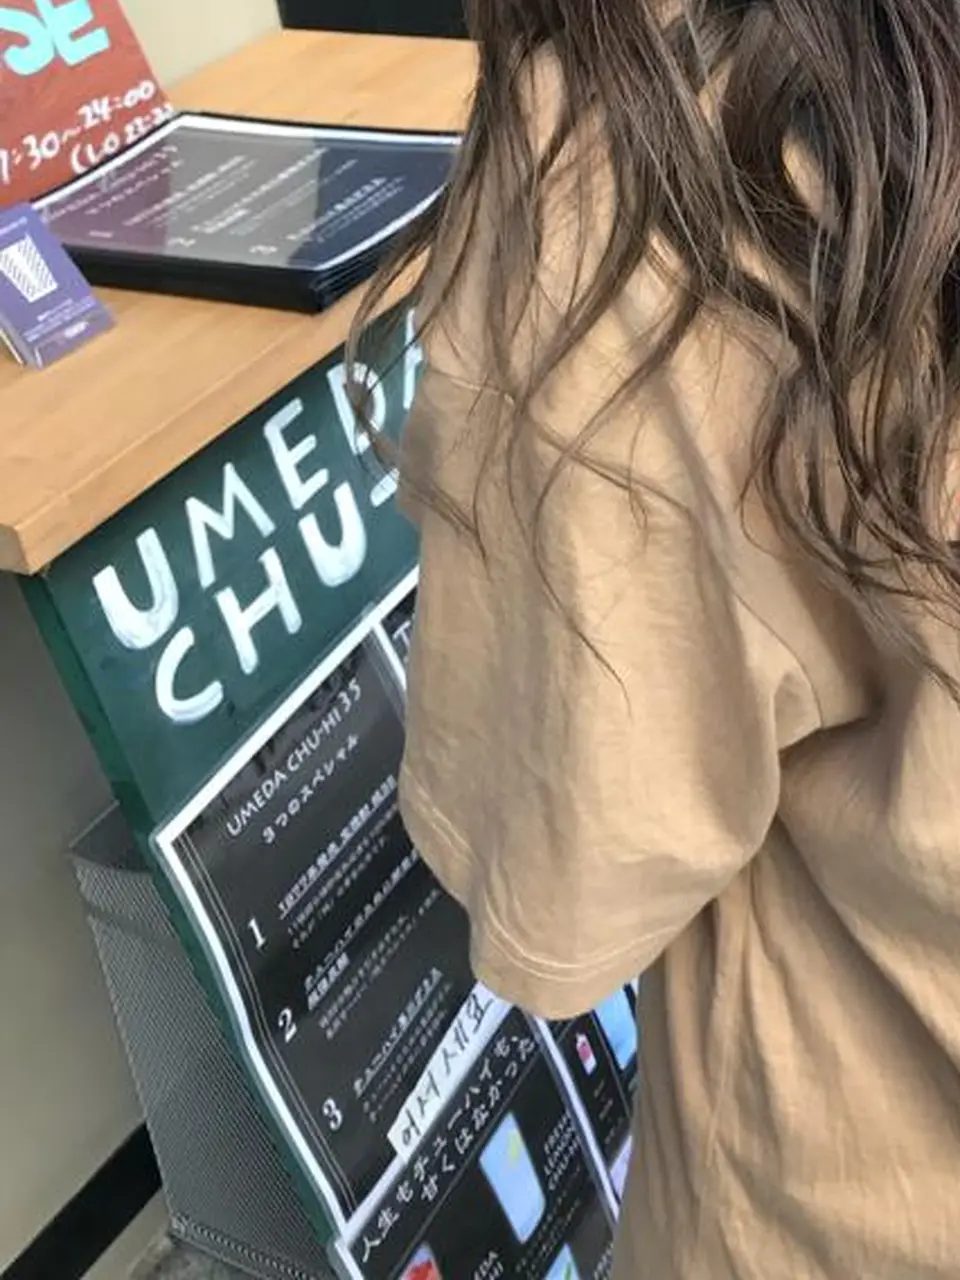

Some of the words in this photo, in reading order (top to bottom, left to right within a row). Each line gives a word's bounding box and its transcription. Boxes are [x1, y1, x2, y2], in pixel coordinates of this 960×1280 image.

[226, 770, 288, 836] UMEDA
[287, 707, 342, 772] CHU-HI
[337, 678, 361, 712] 35
[249, 916, 267, 950] 1
[277, 1007, 298, 1043] 2
[322, 1097, 343, 1131] 3
[420, 1038, 536, 1202] 甘くはなかった
